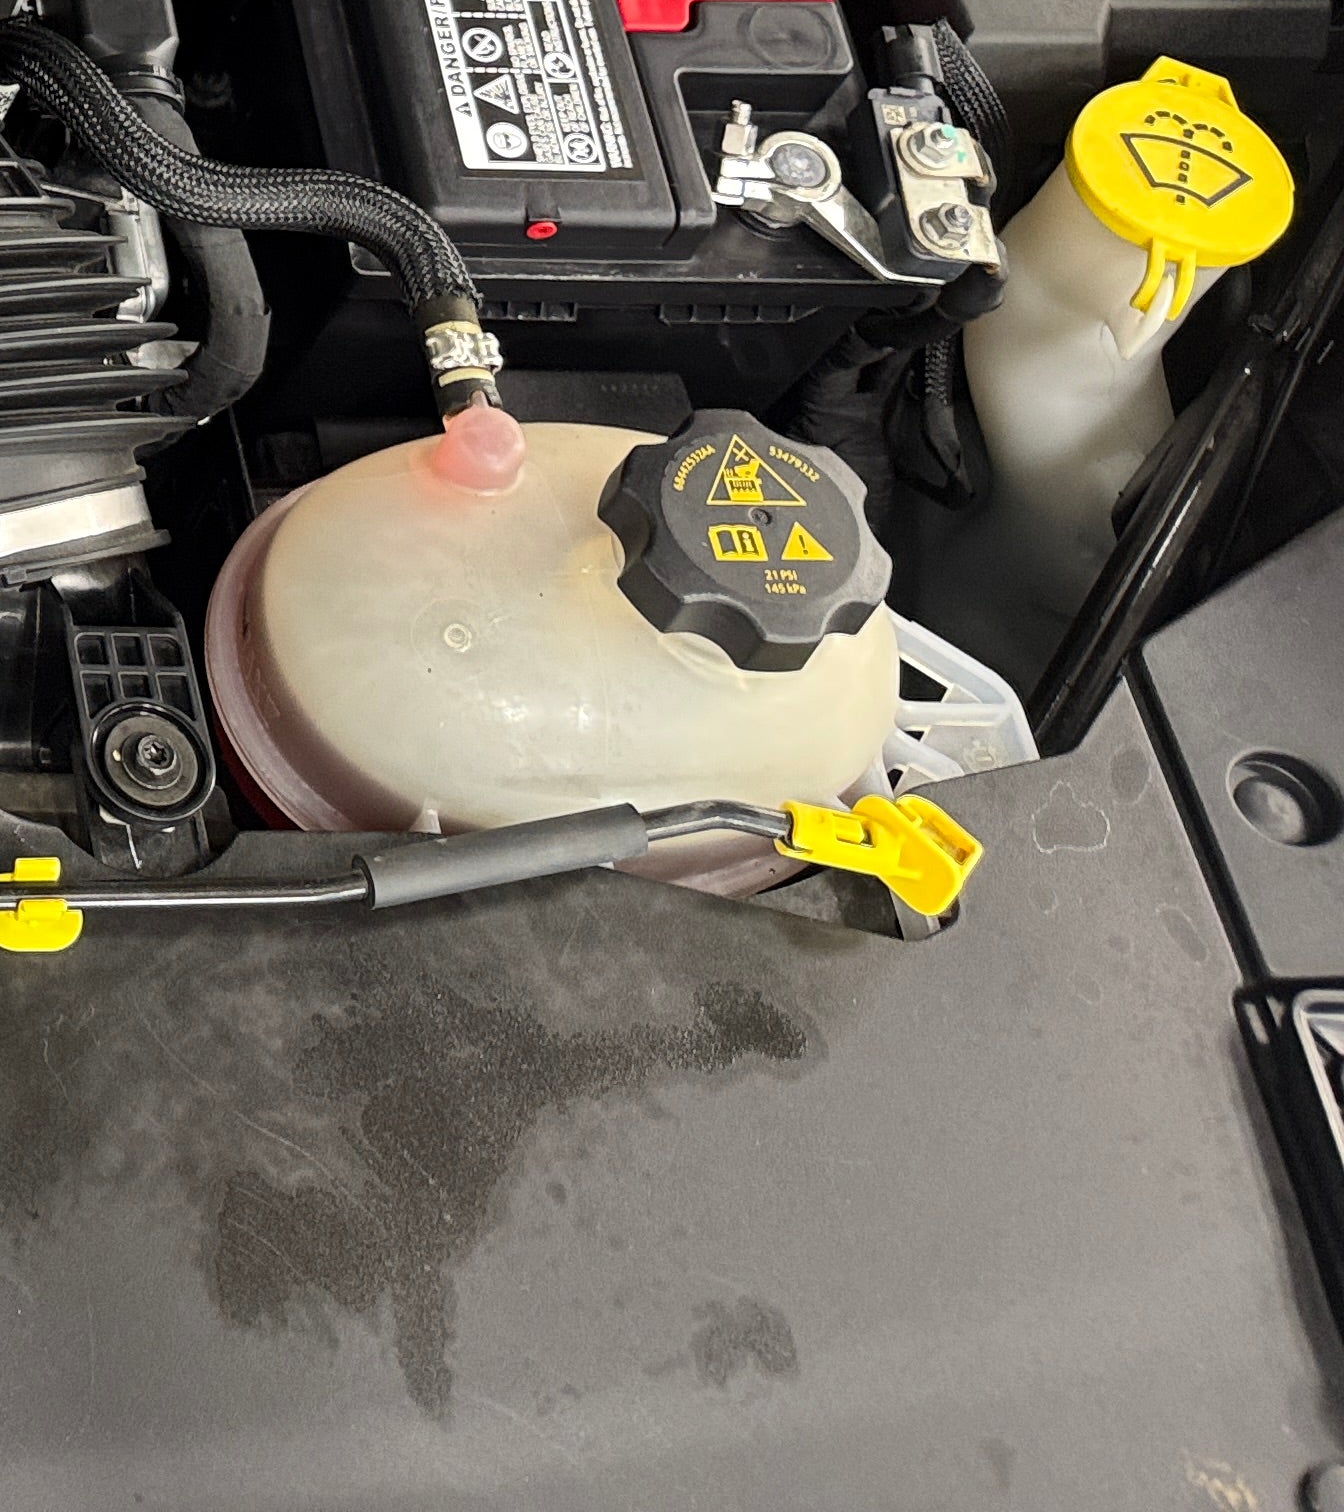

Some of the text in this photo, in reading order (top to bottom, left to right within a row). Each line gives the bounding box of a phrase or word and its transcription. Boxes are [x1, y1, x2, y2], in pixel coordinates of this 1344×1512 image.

[764, 570, 798, 581] 21 PSI
[787, 582, 807, 594] kPa
